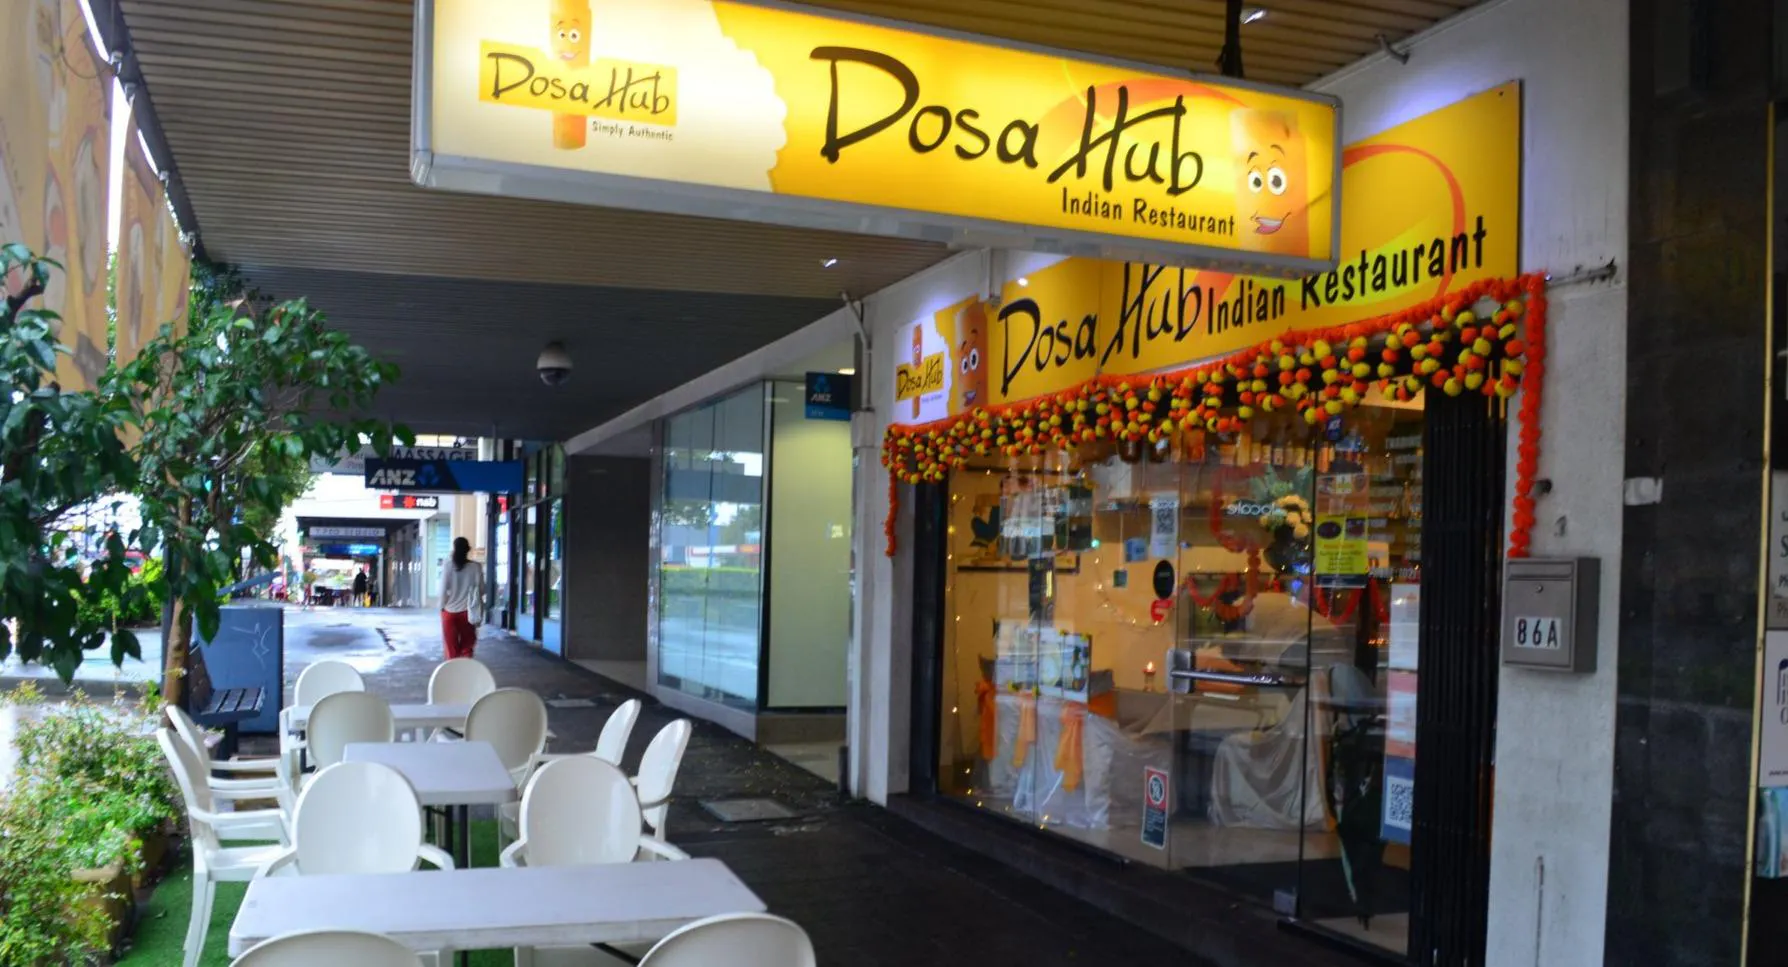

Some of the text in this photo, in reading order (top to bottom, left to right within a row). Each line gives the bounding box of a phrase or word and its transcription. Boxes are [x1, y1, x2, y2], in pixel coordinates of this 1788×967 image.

[486, 52, 670, 115] Dosa Hub
[592, 120, 674, 141] Simply Authentic
[809, 45, 1203, 196] Dosa Hub
[1062, 186, 1236, 236] Indian Restaurant
[1207, 215, 1487, 335] Indian Restaurant
[997, 261, 1202, 397] Dosa Hub
[810, 392, 832, 403] ANZ
[898, 358, 943, 400] Dosa Hub
[369, 468, 416, 486] ANZ
[416, 497, 438, 508] nab
[1517, 618, 1558, 648] 86A
